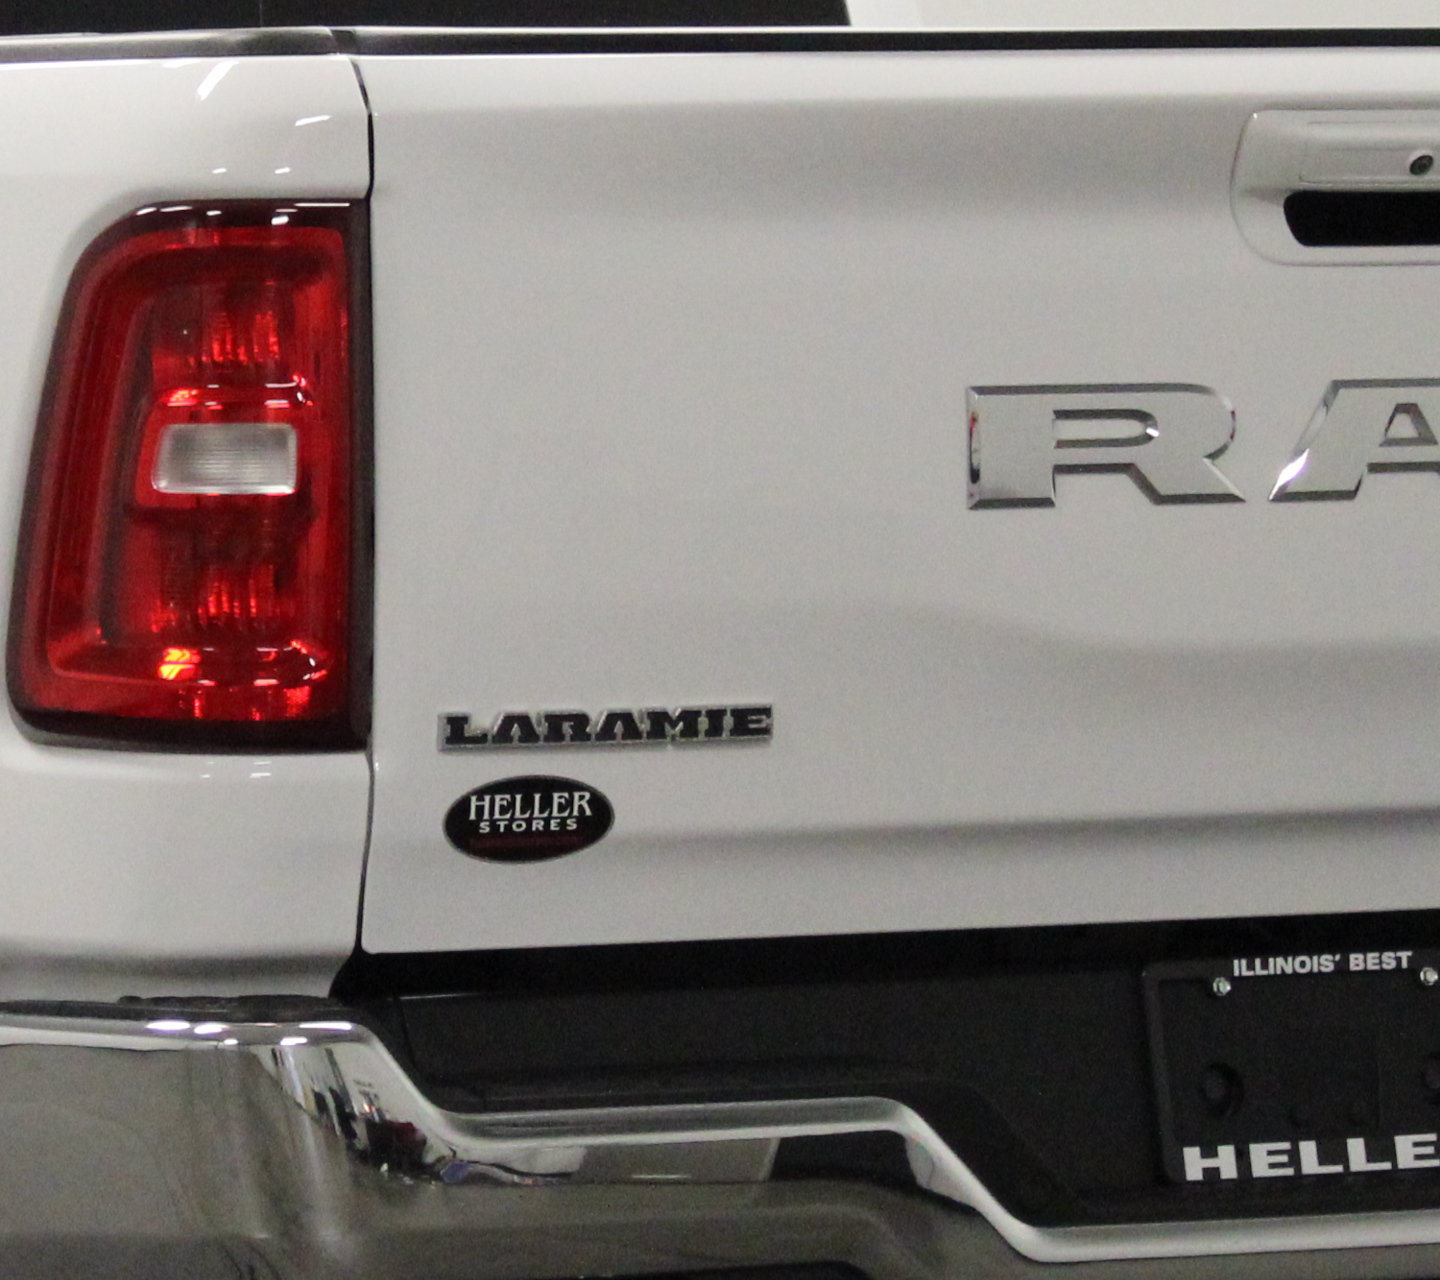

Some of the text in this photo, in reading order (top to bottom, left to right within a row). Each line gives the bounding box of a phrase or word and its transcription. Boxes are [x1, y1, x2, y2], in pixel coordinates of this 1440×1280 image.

[437, 704, 774, 753] LARAMIE
[468, 790, 593, 821] HELLER
[479, 818, 579, 834] STORES
[1349, 950, 1414, 971] BEST
